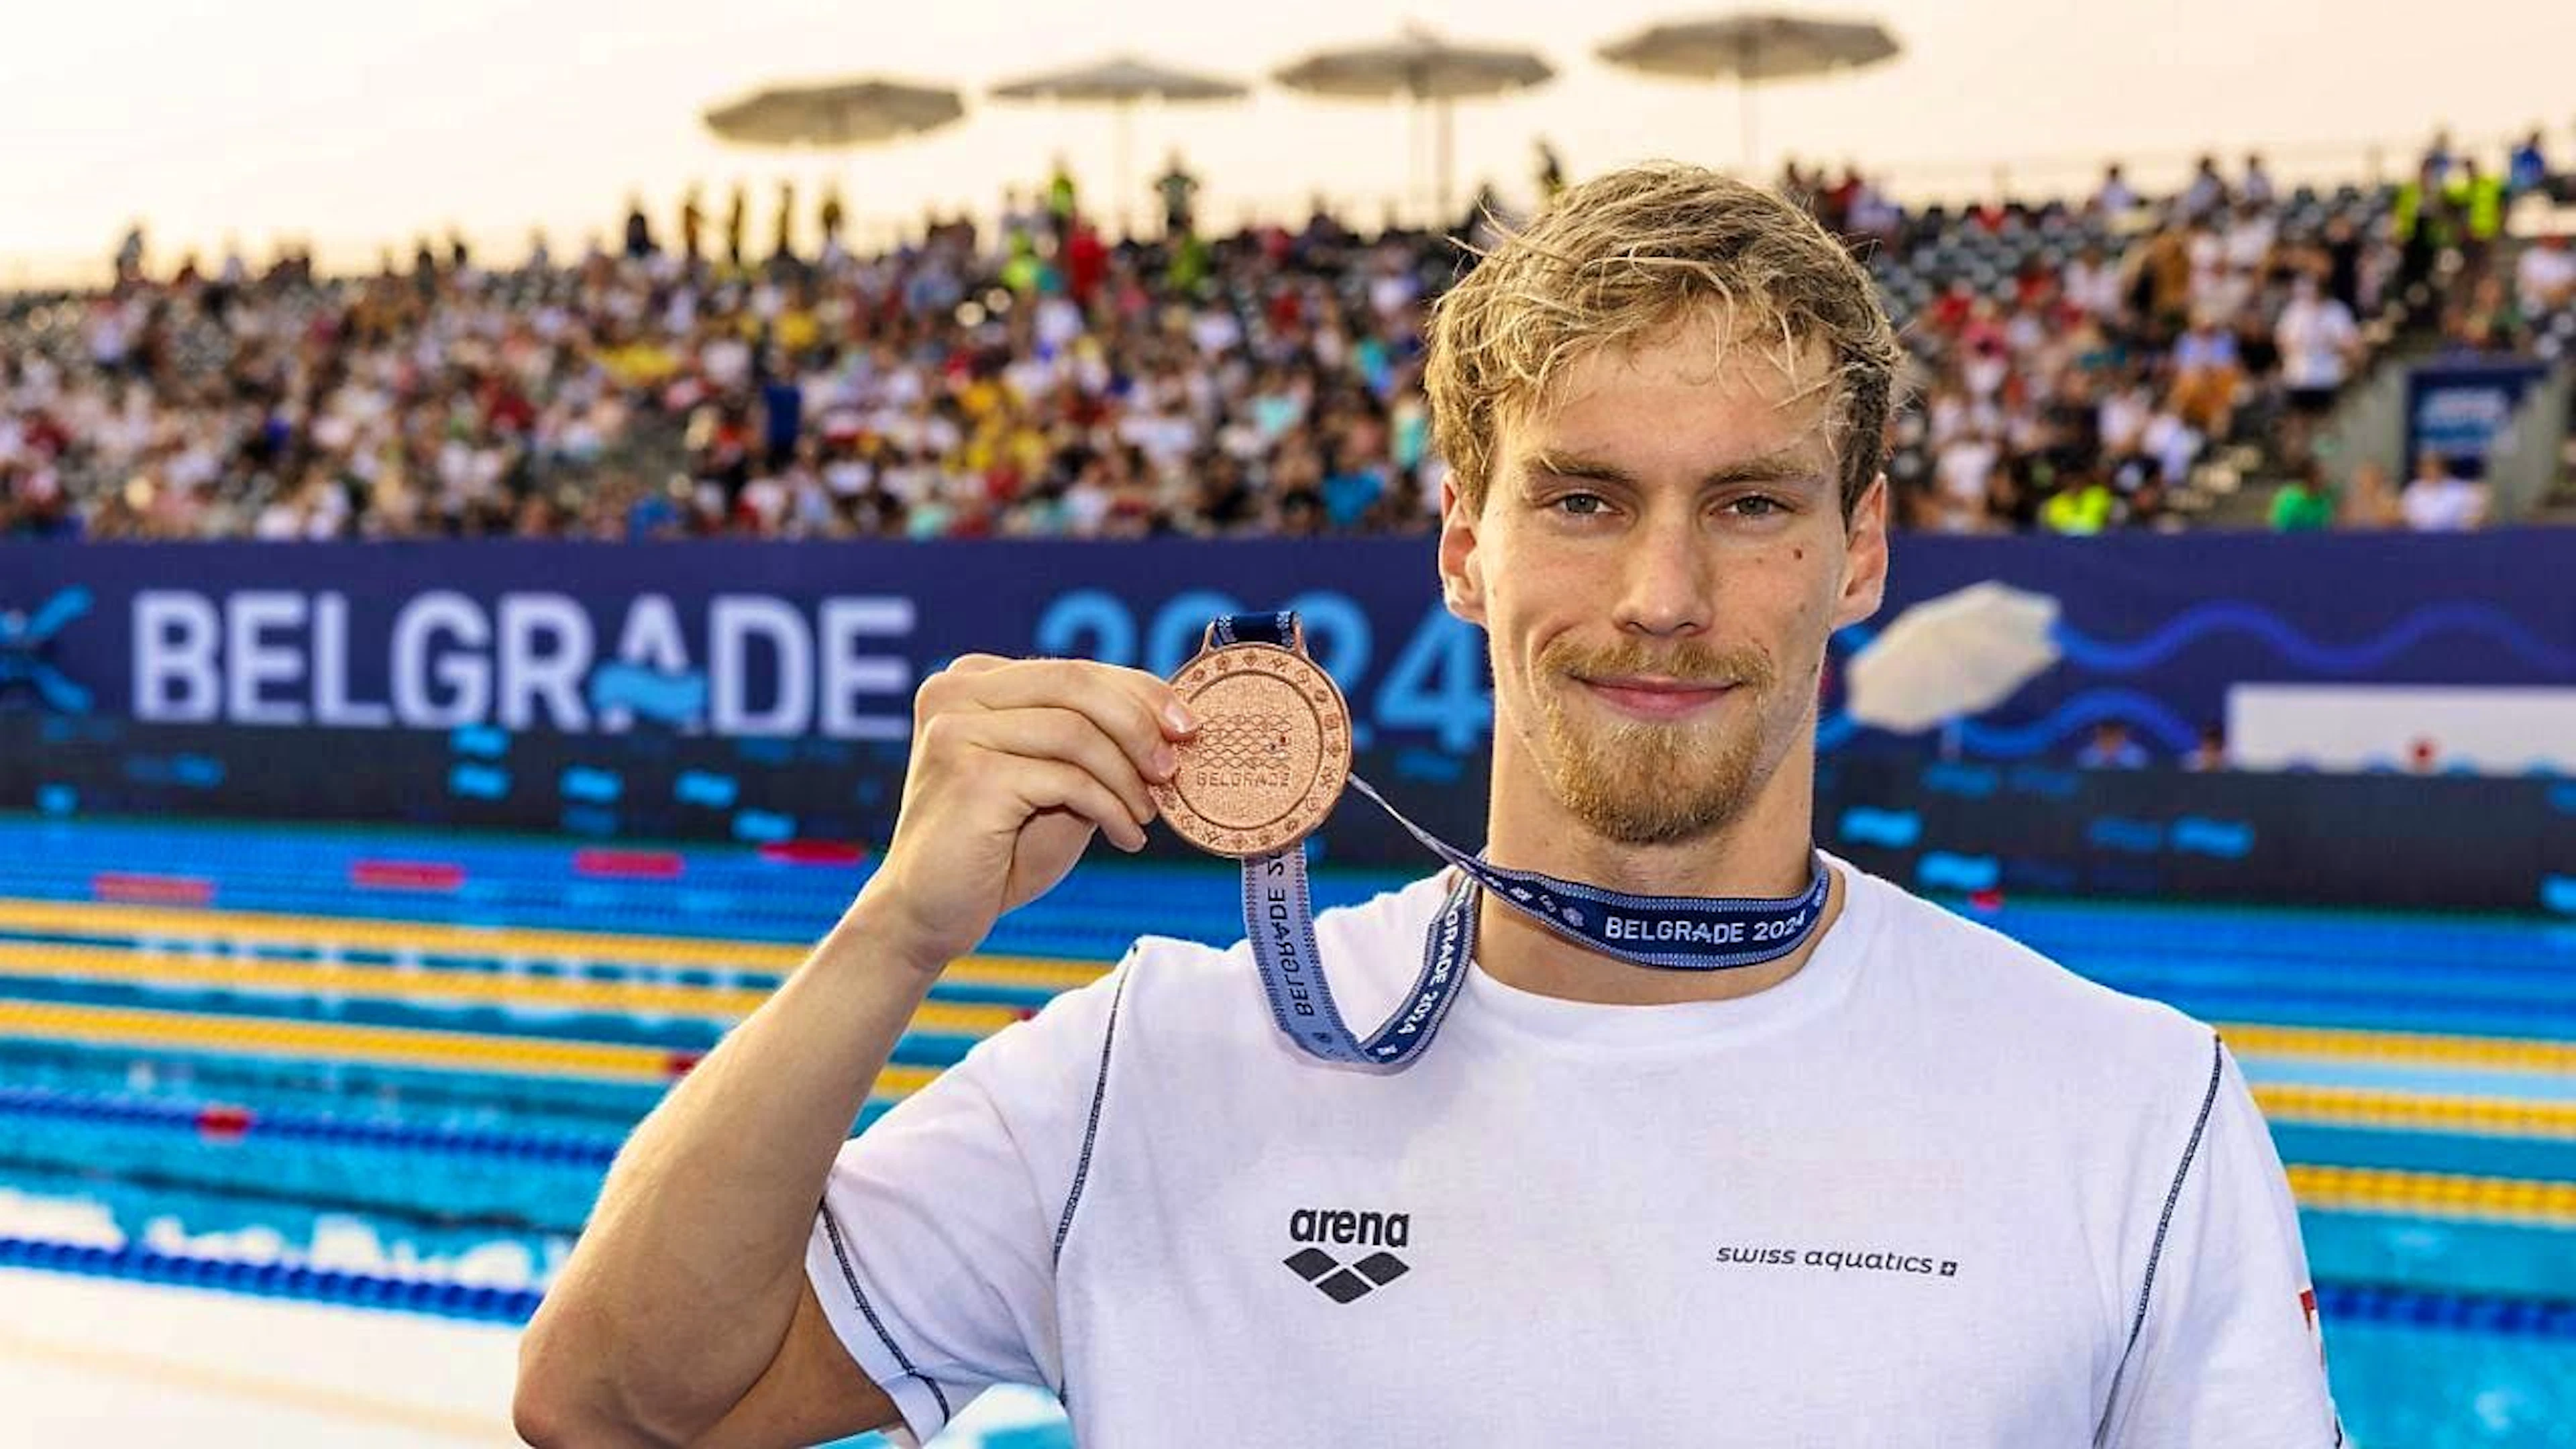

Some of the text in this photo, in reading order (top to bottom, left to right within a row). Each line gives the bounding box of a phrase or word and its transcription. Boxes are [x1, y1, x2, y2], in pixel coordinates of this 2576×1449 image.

[132, 589, 916, 739] BELGRADE
[1197, 771, 1290, 787] BELGRADE
[1605, 908, 1806, 945] BELGRADE 2024
[1398, 990, 1438, 1034] 2024
[1289, 1209, 1410, 1247] arena
[1716, 1246, 1933, 1274] swiss aquatics
